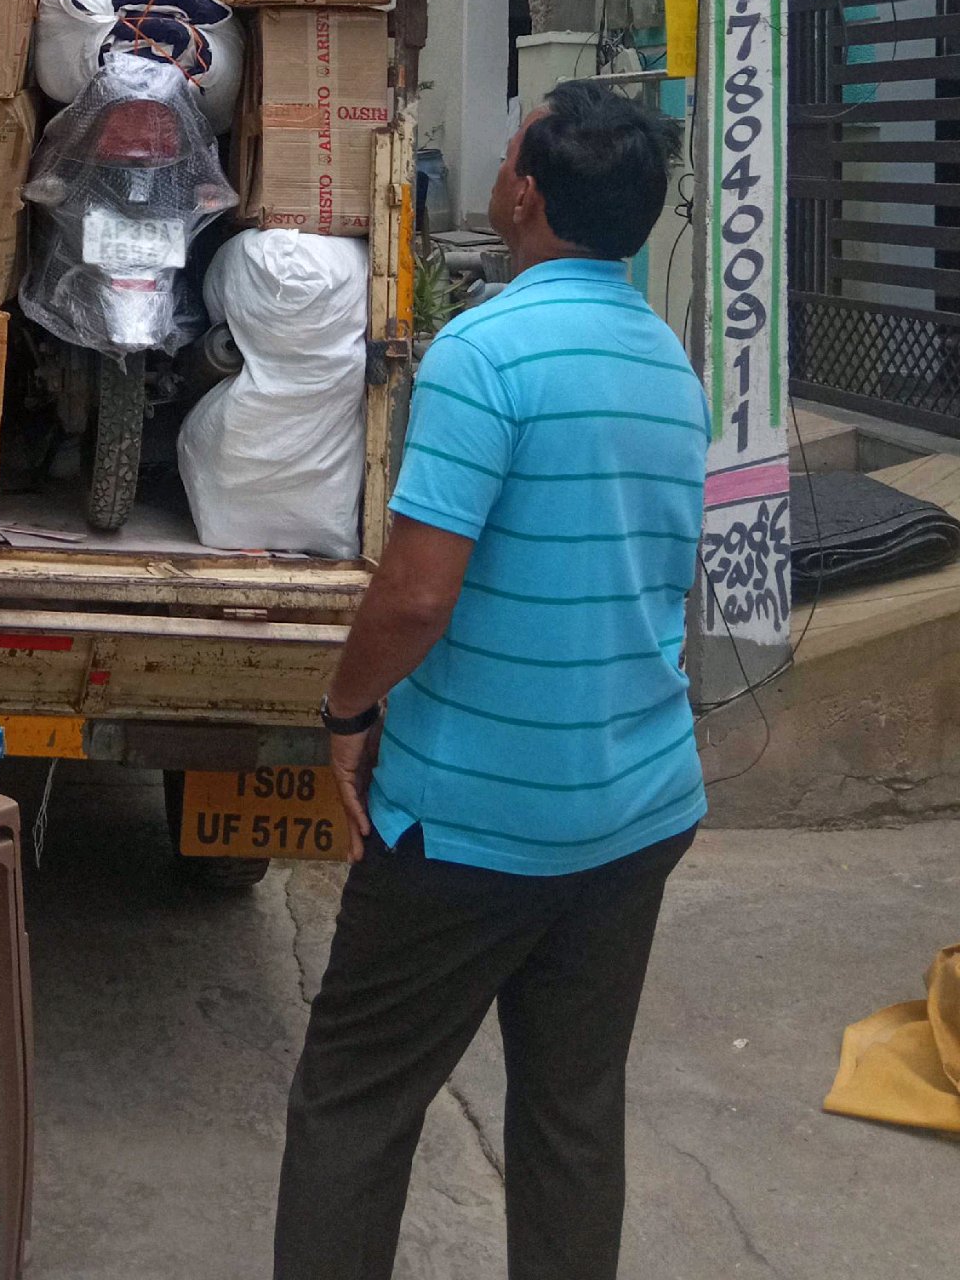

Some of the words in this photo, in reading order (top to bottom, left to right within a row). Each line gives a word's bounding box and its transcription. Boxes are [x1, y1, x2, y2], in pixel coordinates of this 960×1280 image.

[316, 10, 330, 64] ARIST
[337, 106, 388, 121] RISTO
[318, 174, 333, 236] ARISTO
[197, 812, 241, 845] UF
[252, 815, 333, 852] 5176
